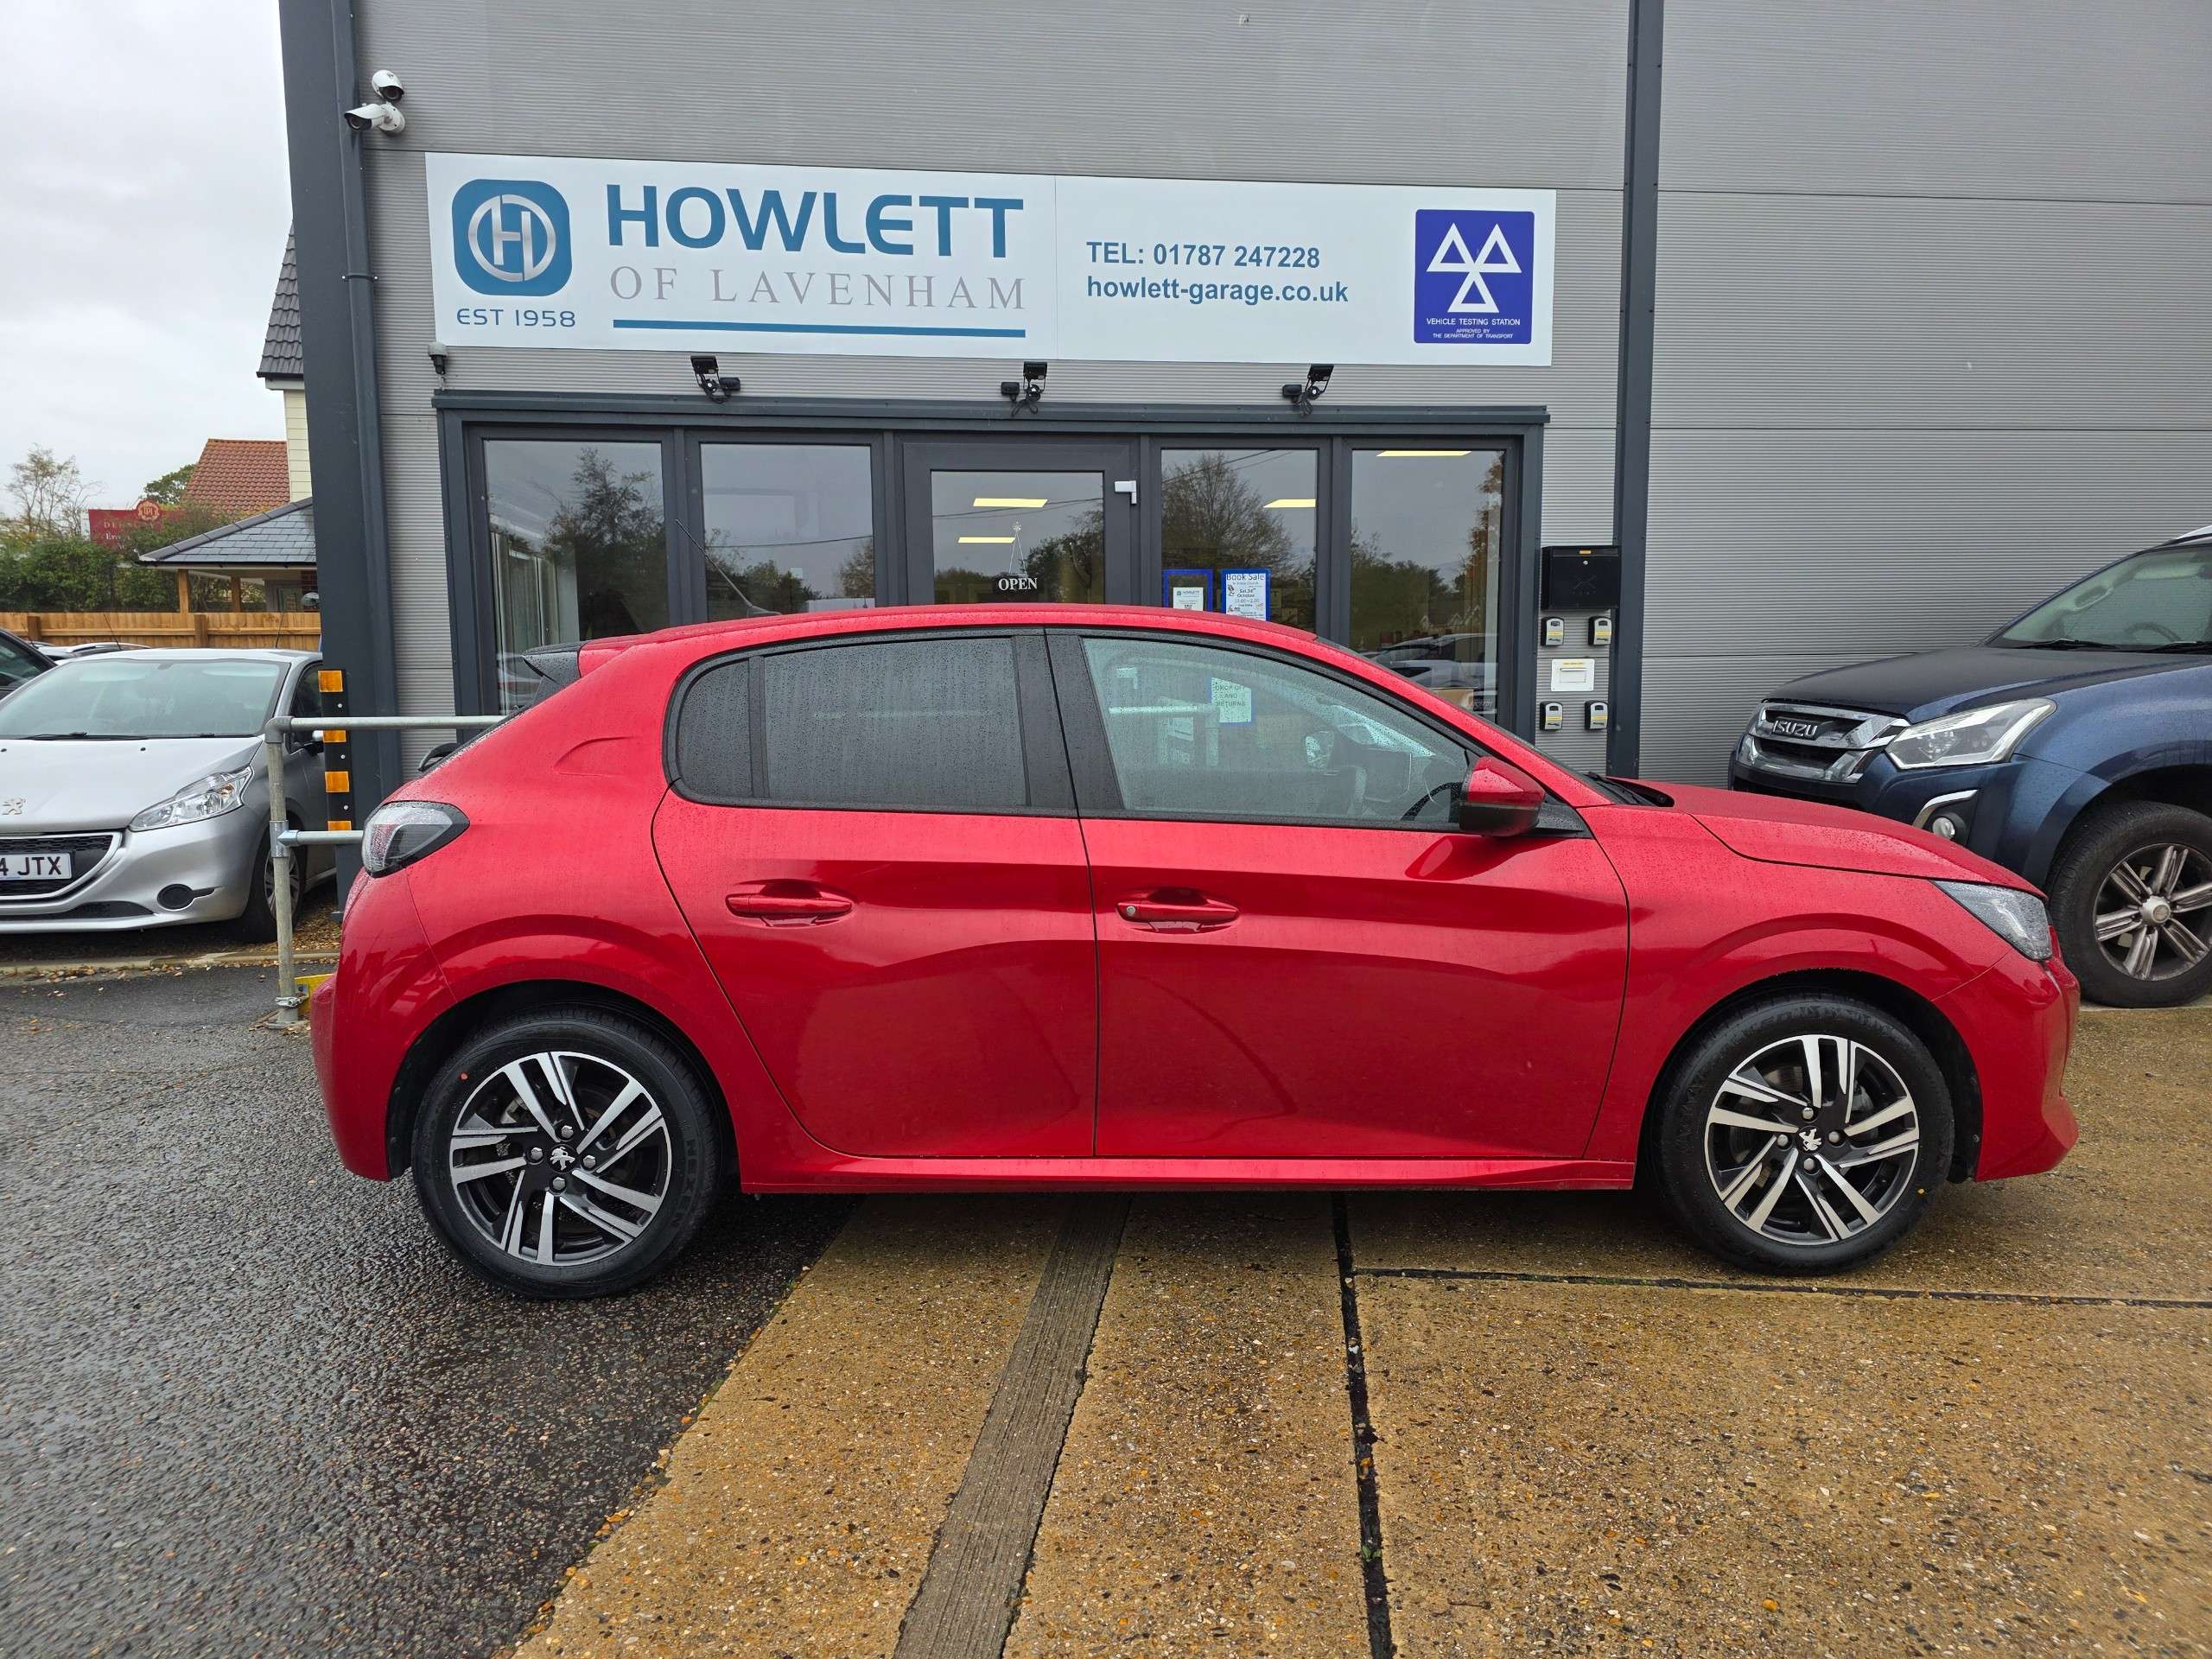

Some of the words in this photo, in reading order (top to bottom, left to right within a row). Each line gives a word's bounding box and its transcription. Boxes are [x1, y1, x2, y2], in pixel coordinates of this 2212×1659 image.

[607, 184, 1024, 258] HOWLETT
[1085, 242, 1144, 264] TEL:
[1154, 243, 1225, 266] 01787
[1234, 245, 1320, 269] 247228
[610, 265, 677, 301] OF
[709, 269, 1026, 310] LAVENHAM
[1087, 275, 1349, 306] howlett-garage.co.uk
[456, 308, 505, 325] EST
[515, 309, 575, 327] 1958
[1426, 317, 1457, 326] VEHICLE
[998, 576, 1038, 591] OPEN
[1772, 720, 1818, 737] ISUZU
[17, 855, 62, 876] JTX
